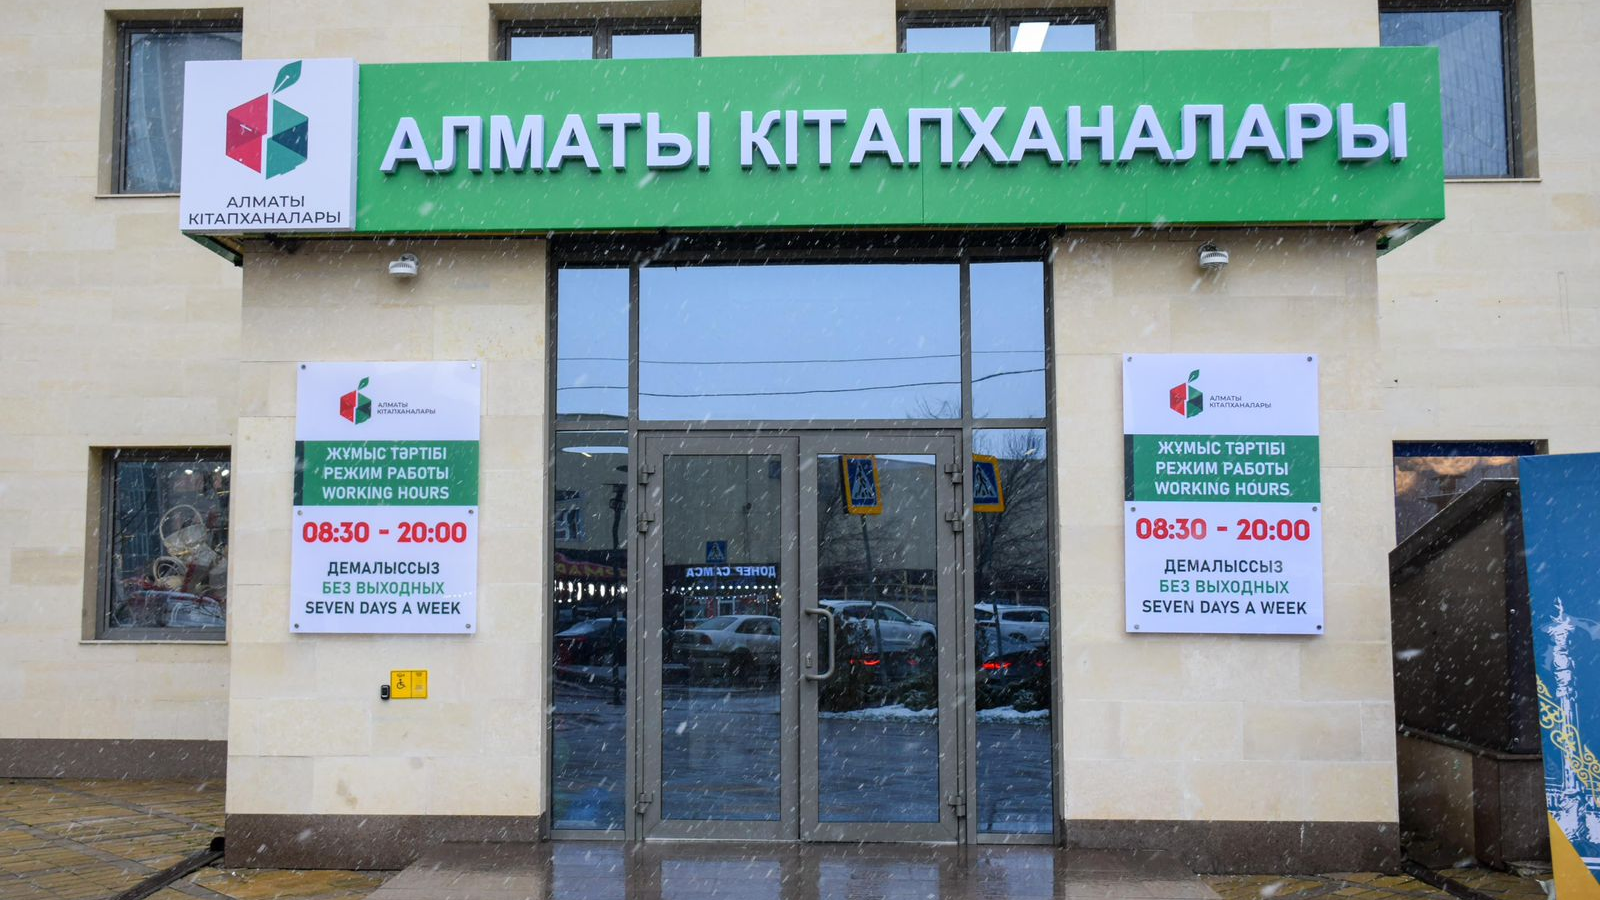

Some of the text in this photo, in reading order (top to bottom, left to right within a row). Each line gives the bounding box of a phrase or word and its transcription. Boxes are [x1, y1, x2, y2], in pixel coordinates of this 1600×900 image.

[380, 101, 1408, 174] АЛМАТЫ КІТАПХАНАЛАРЫ
[226, 195, 305, 208] АЛМАТЫ
[189, 211, 341, 225] КІТАПХАНАЛАРЫ
[326, 447, 447, 460] ЖҰМЫС ТӘРТІБІ
[1158, 441, 1285, 455] ЖҰМЫС ТӘРТІБІ
[324, 466, 449, 480] РЕЖИМ РАБОТЫ
[1156, 461, 1288, 476] РЕЖИМ РАБОТЫ
[322, 486, 449, 500] WORKING HOURS
[1154, 481, 1290, 495] WORKING HOURS
[302, 521, 370, 543] 08:30
[397, 521, 467, 543] 20:00
[1135, 518, 1207, 540] 08:30
[1236, 518, 1311, 541] 20:00
[327, 561, 440, 576] ДЕМАЛЫССЫЗ
[1164, 559, 1283, 574] ДЕМАЛЫССЫЗ
[322, 581, 445, 596] БЕЗ ВЫХОДНЫХ
[1159, 579, 1290, 596] БЕЗ ВЫХОДНЫХ
[305, 601, 461, 614] SEVEN DAYS A WEEK
[1142, 600, 1307, 615] SEVEN DAYS A WEEK
